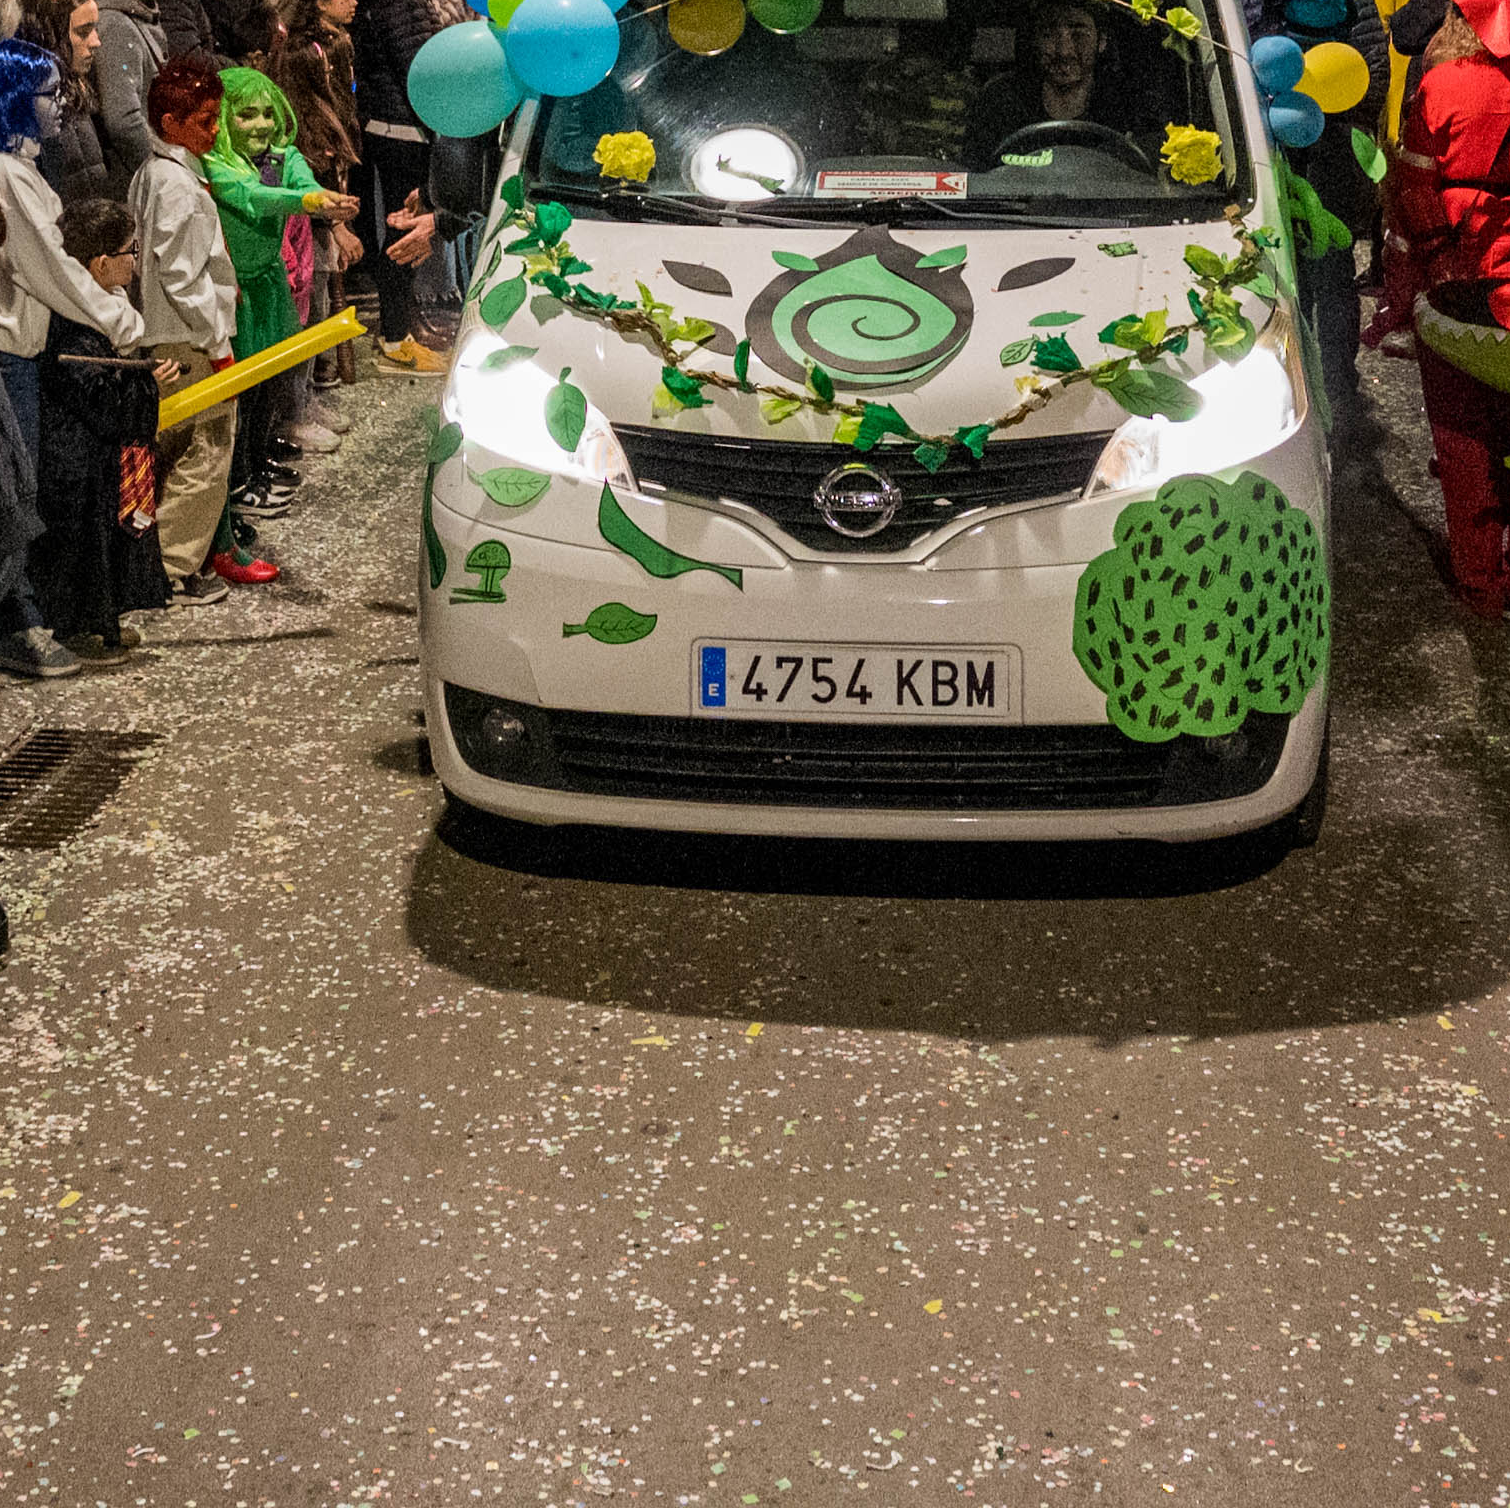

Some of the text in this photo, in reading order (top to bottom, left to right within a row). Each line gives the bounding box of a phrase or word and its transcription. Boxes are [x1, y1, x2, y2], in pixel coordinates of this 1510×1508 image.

[708, 683, 720, 697] E
[741, 654, 995, 708] 4754 KBM
